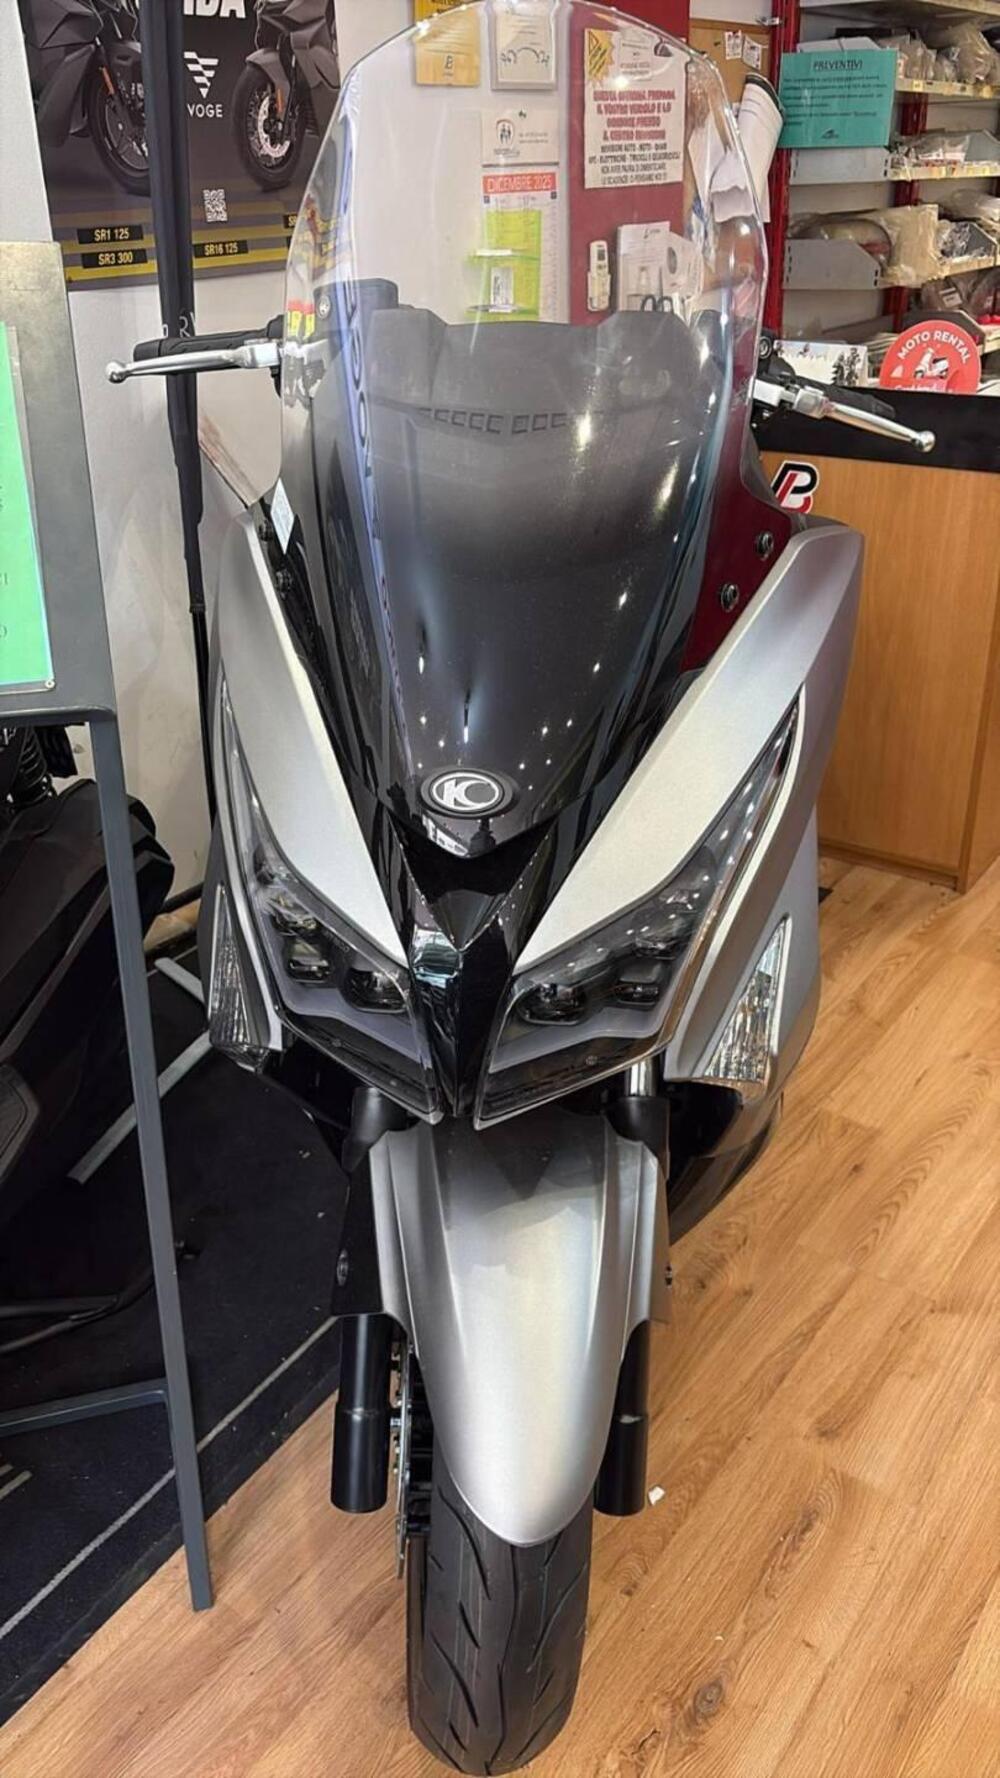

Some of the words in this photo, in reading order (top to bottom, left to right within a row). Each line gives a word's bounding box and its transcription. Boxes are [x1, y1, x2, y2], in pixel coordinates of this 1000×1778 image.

[813, 60, 863, 71] PREVENTIVI
[187, 104, 223, 118] VOGE
[487, 175, 532, 193] DICEMBRE
[94, 229, 111, 241] SR1
[114, 228, 130, 240] 125
[225, 242, 238, 254] 125
[98, 253, 115, 265] SR3
[117, 251, 133, 263] 300
[897, 330, 931, 360] MOTO
[933, 330, 971, 364] RENTAL
